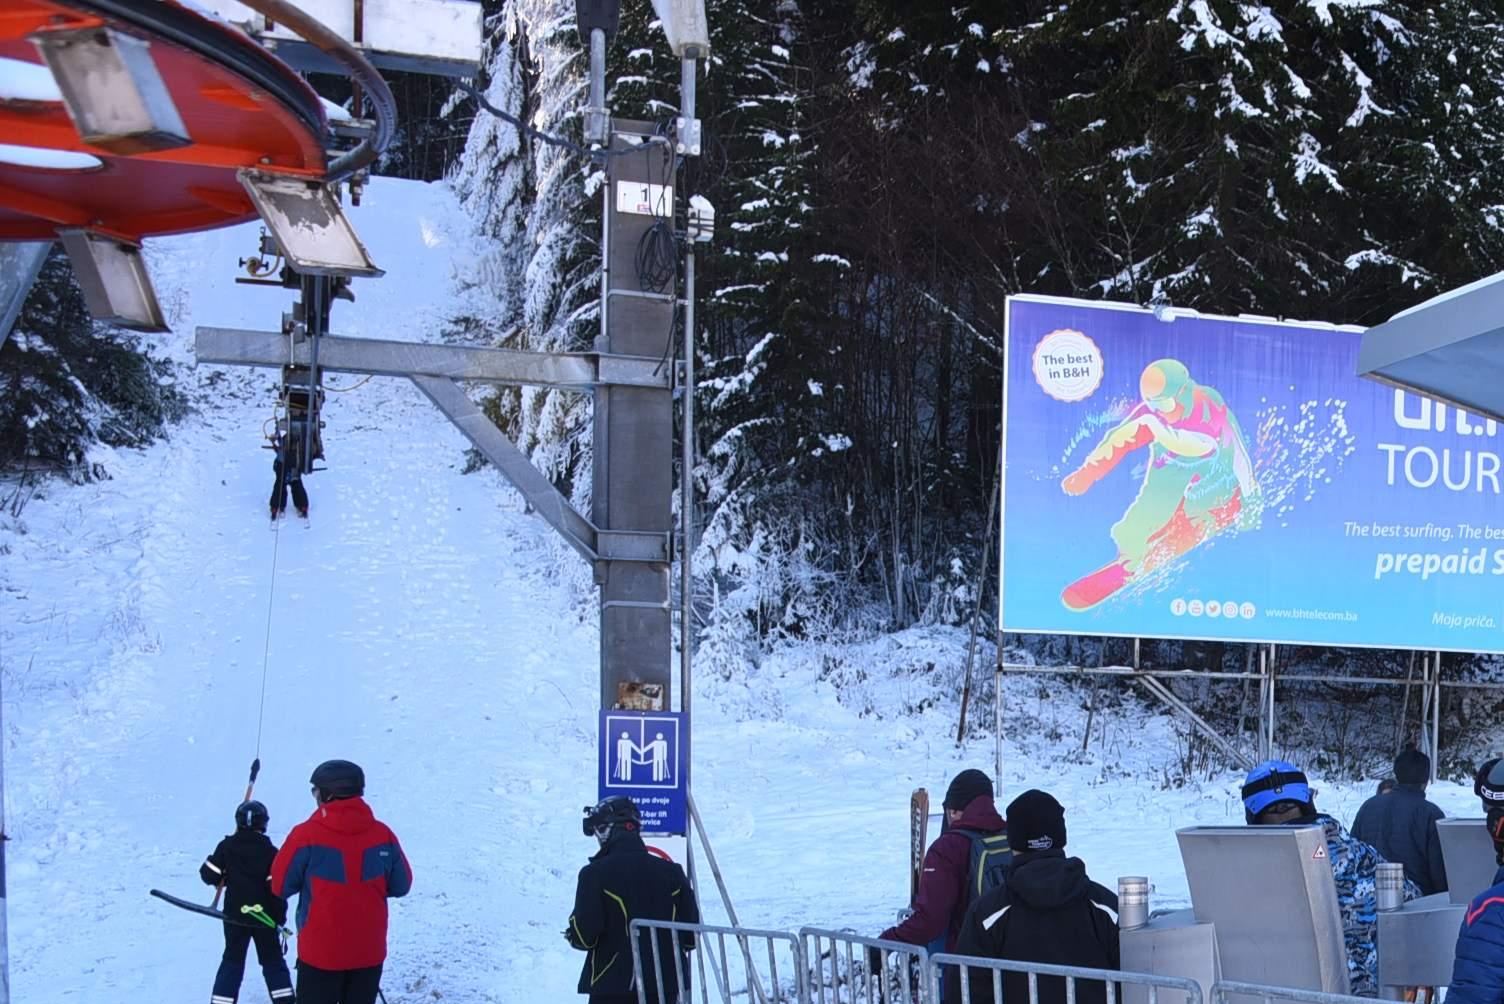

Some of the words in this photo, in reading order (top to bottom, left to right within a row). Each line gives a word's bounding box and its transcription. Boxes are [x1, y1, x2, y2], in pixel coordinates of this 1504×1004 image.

[641, 187, 648, 202] 1
[1042, 354, 1065, 366] The
[1067, 353, 1093, 364] best
[1048, 368, 1061, 379] in
[1063, 366, 1090, 379] B&H
[1344, 522, 1369, 537] The
[1372, 522, 1401, 537] best
[1403, 523, 1454, 542] surfing.
[1457, 524, 1481, 539] The
[1374, 547, 1487, 580] prepaid
[1265, 607, 1358, 622] www.bhtelecom.ba
[1432, 612, 1461, 628] Moja
